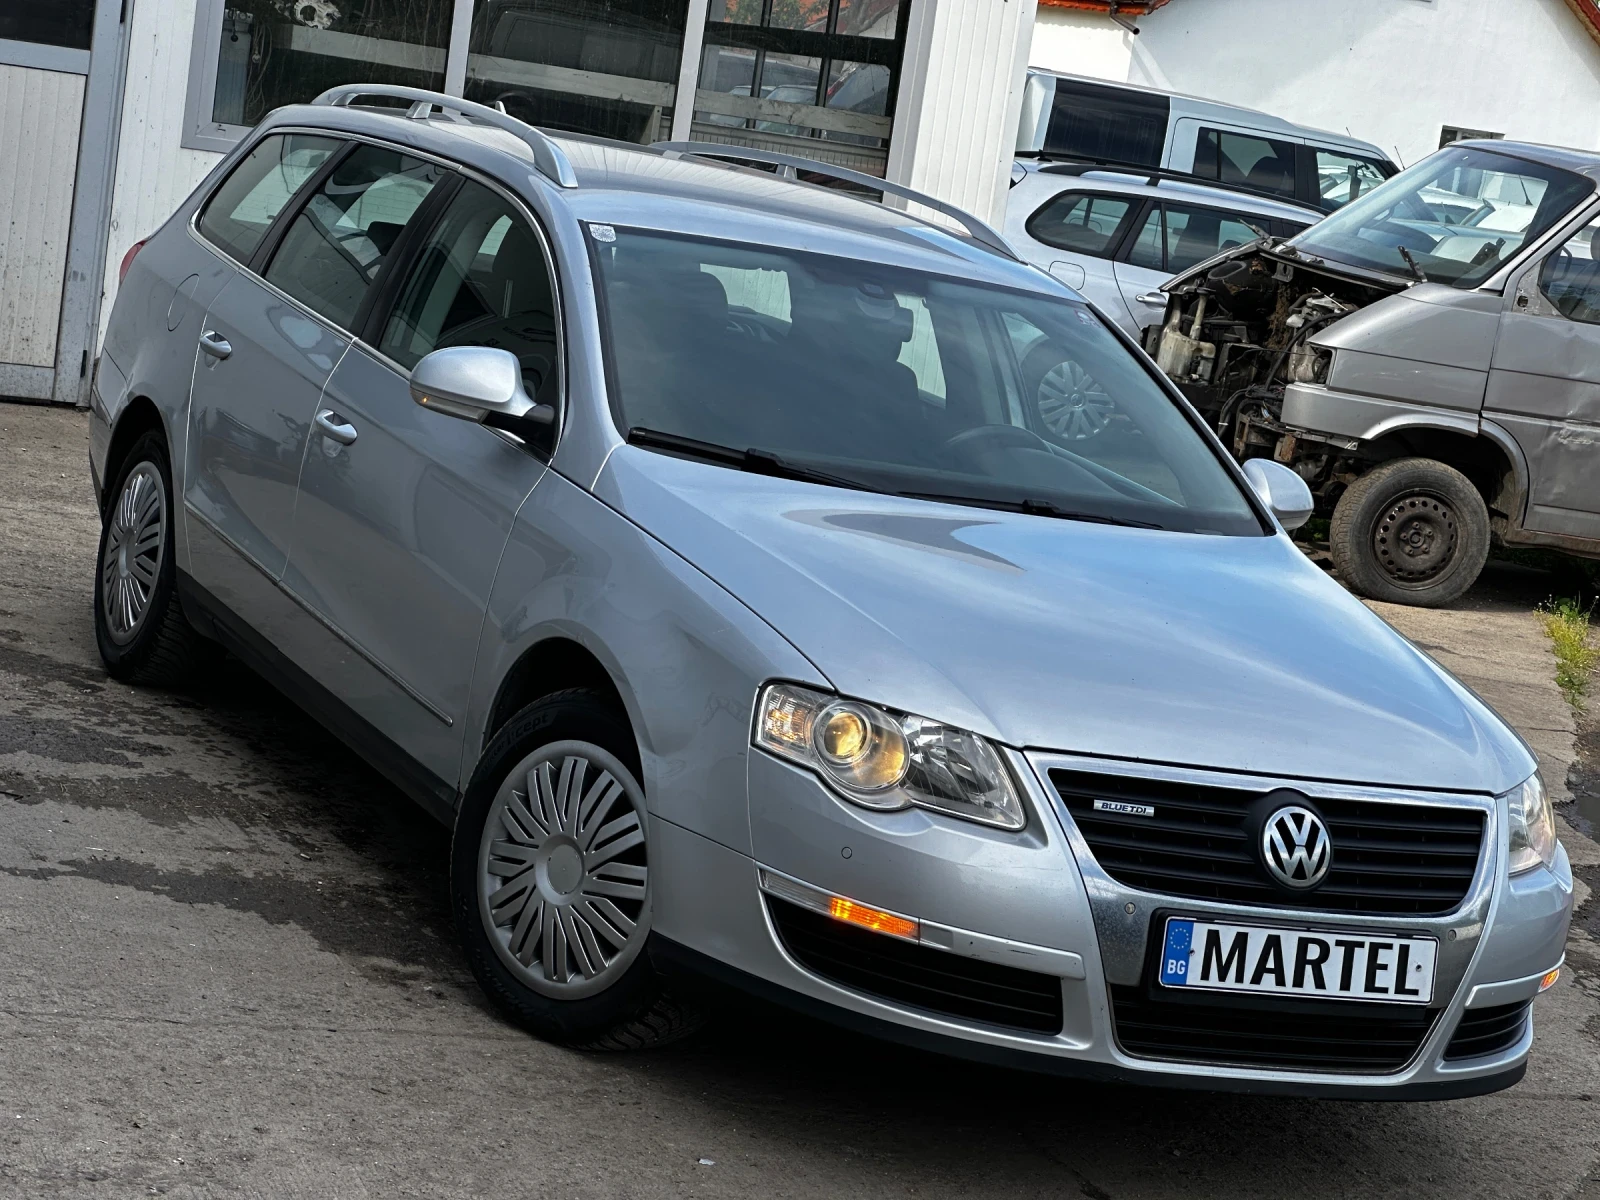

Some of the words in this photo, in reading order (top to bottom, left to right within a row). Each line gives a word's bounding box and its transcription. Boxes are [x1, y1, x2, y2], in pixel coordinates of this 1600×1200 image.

[1101, 802, 1147, 814] BLUETDI
[1264, 806, 1331, 887] VW
[1167, 959, 1186, 975] BG
[1199, 928, 1420, 996] MARTEL
